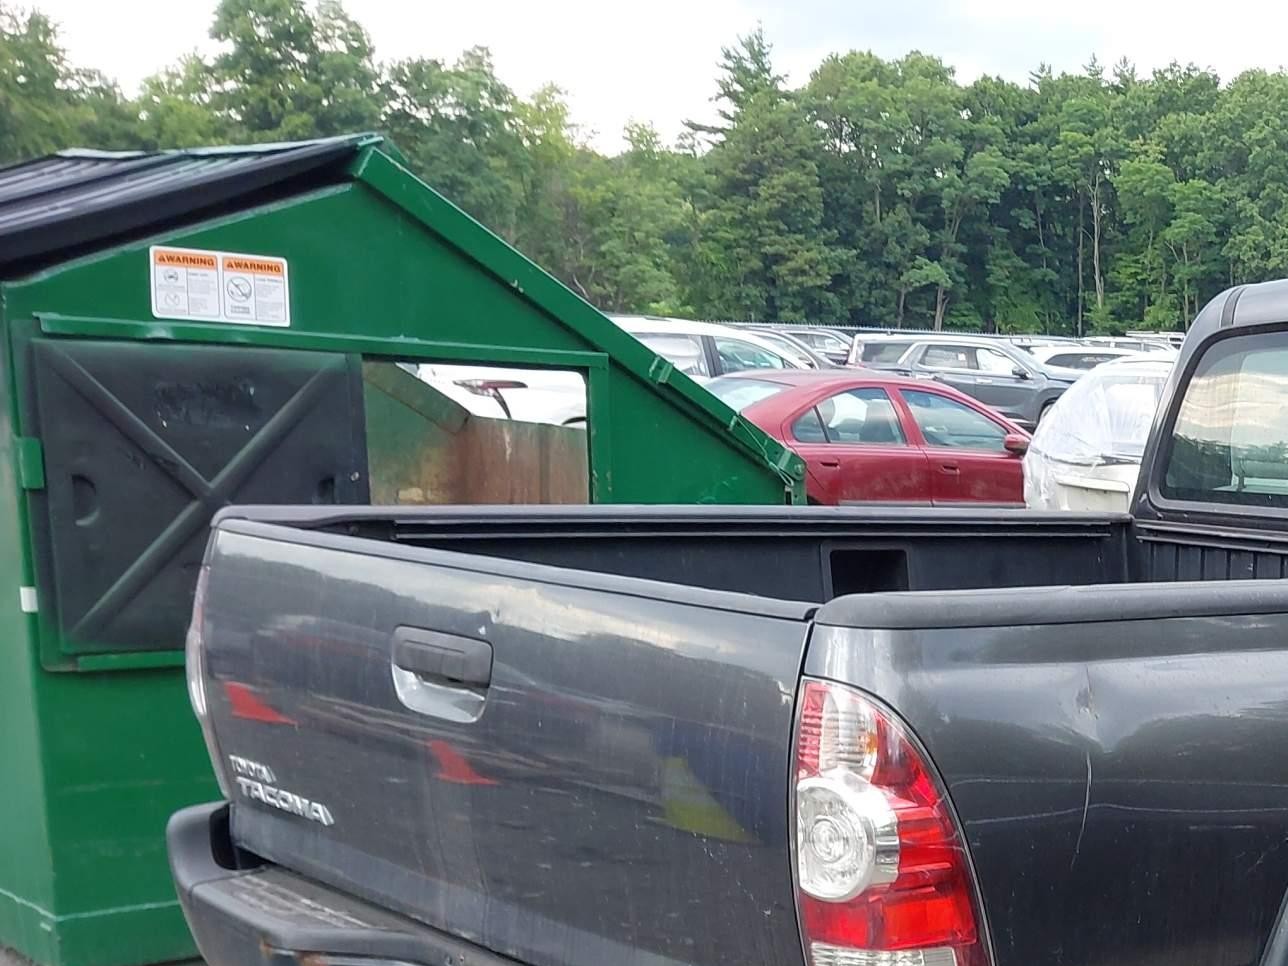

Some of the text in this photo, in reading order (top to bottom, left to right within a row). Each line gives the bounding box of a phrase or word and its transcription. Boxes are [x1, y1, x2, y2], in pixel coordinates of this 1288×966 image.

[165, 255, 214, 267] WARNING
[233, 261, 281, 273] WARNING
[236, 776, 334, 825] TACOMA
